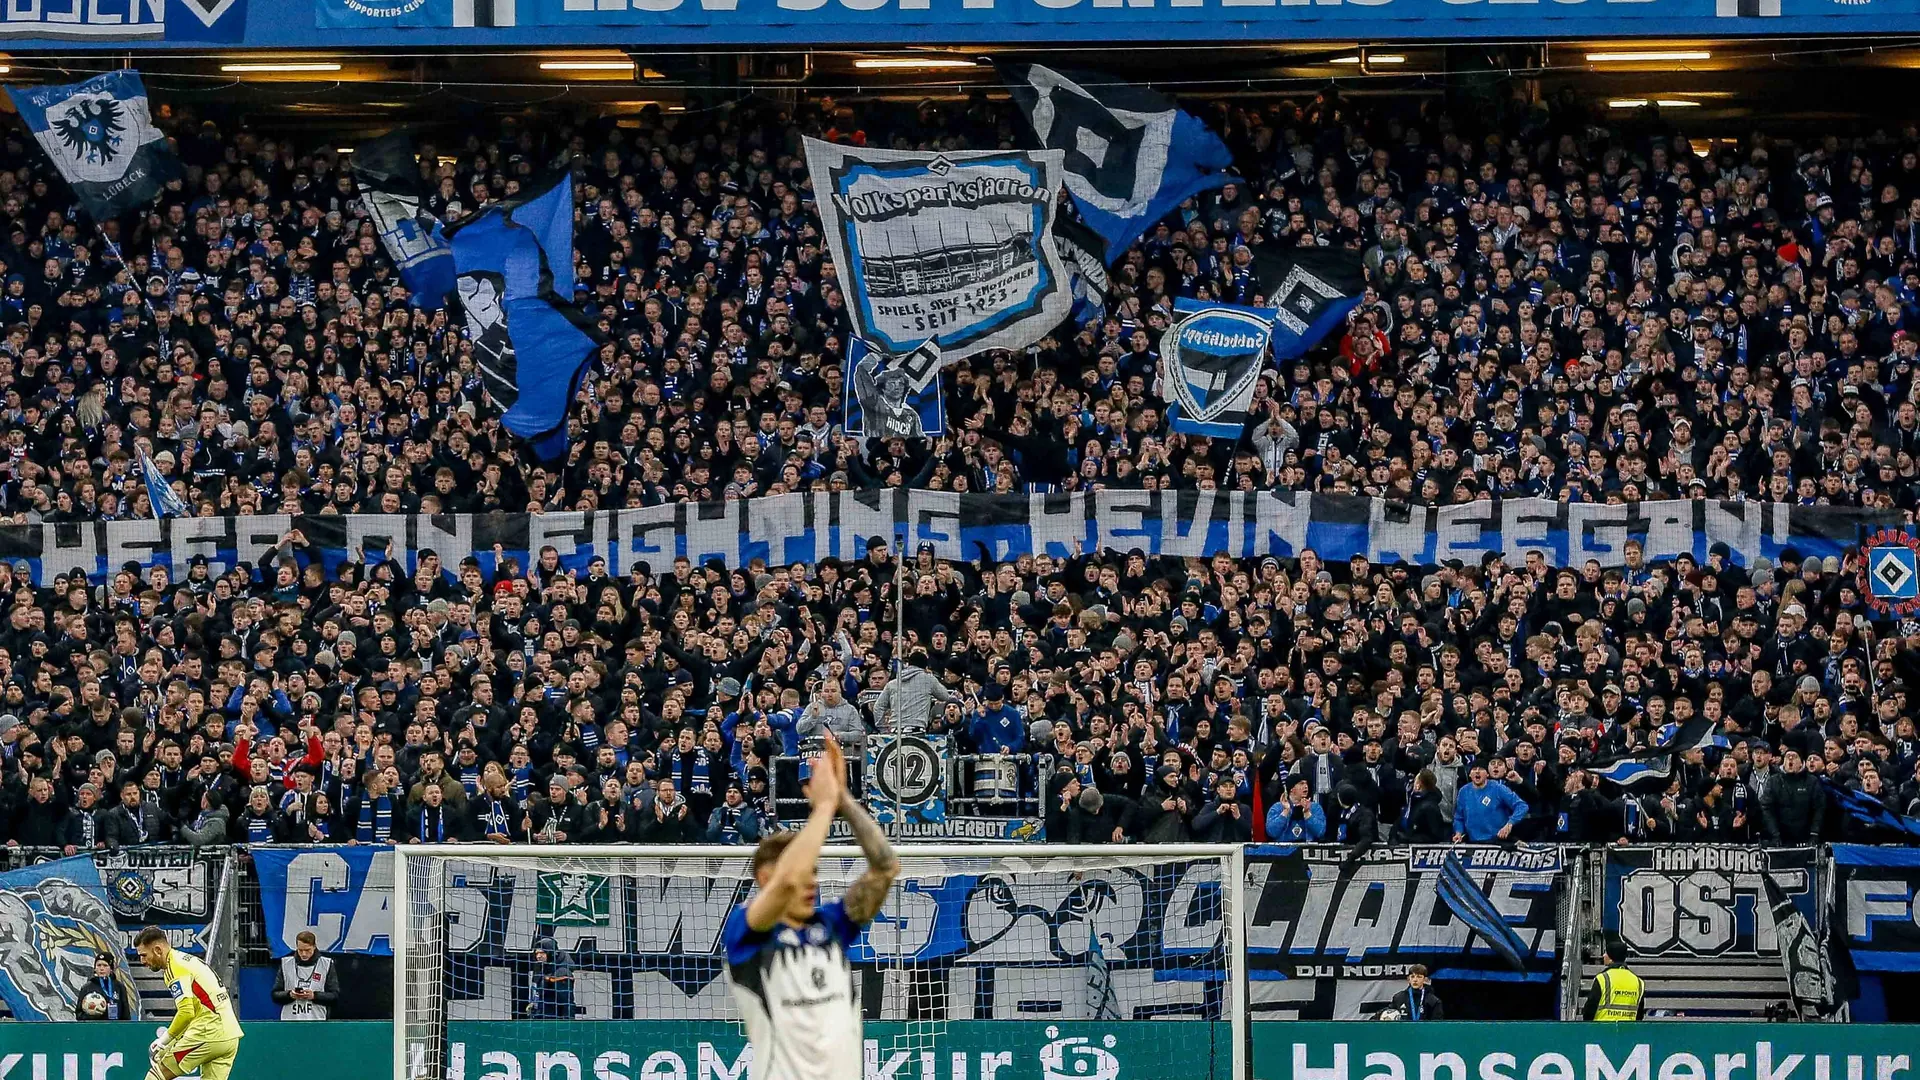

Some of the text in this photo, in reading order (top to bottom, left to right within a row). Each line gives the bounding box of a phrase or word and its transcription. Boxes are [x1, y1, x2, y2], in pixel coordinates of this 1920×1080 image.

[102, 168, 147, 201] LÜBECK
[832, 176, 1051, 218] Volksparkstadion
[877, 303, 926, 316] SPIELE,
[914, 308, 957, 331] SEIT
[966, 288, 1008, 315] 1953
[1029, 489, 1309, 564] KEVIN
[888, 752, 926, 789] 12
[1470, 849, 1558, 869] BRATANS
[1655, 849, 1767, 871] HAMBURG
[1624, 870, 1804, 950] OST
[1296, 965, 1413, 977] DU NOR
[1292, 1041, 1910, 1080] HanseMerkur
